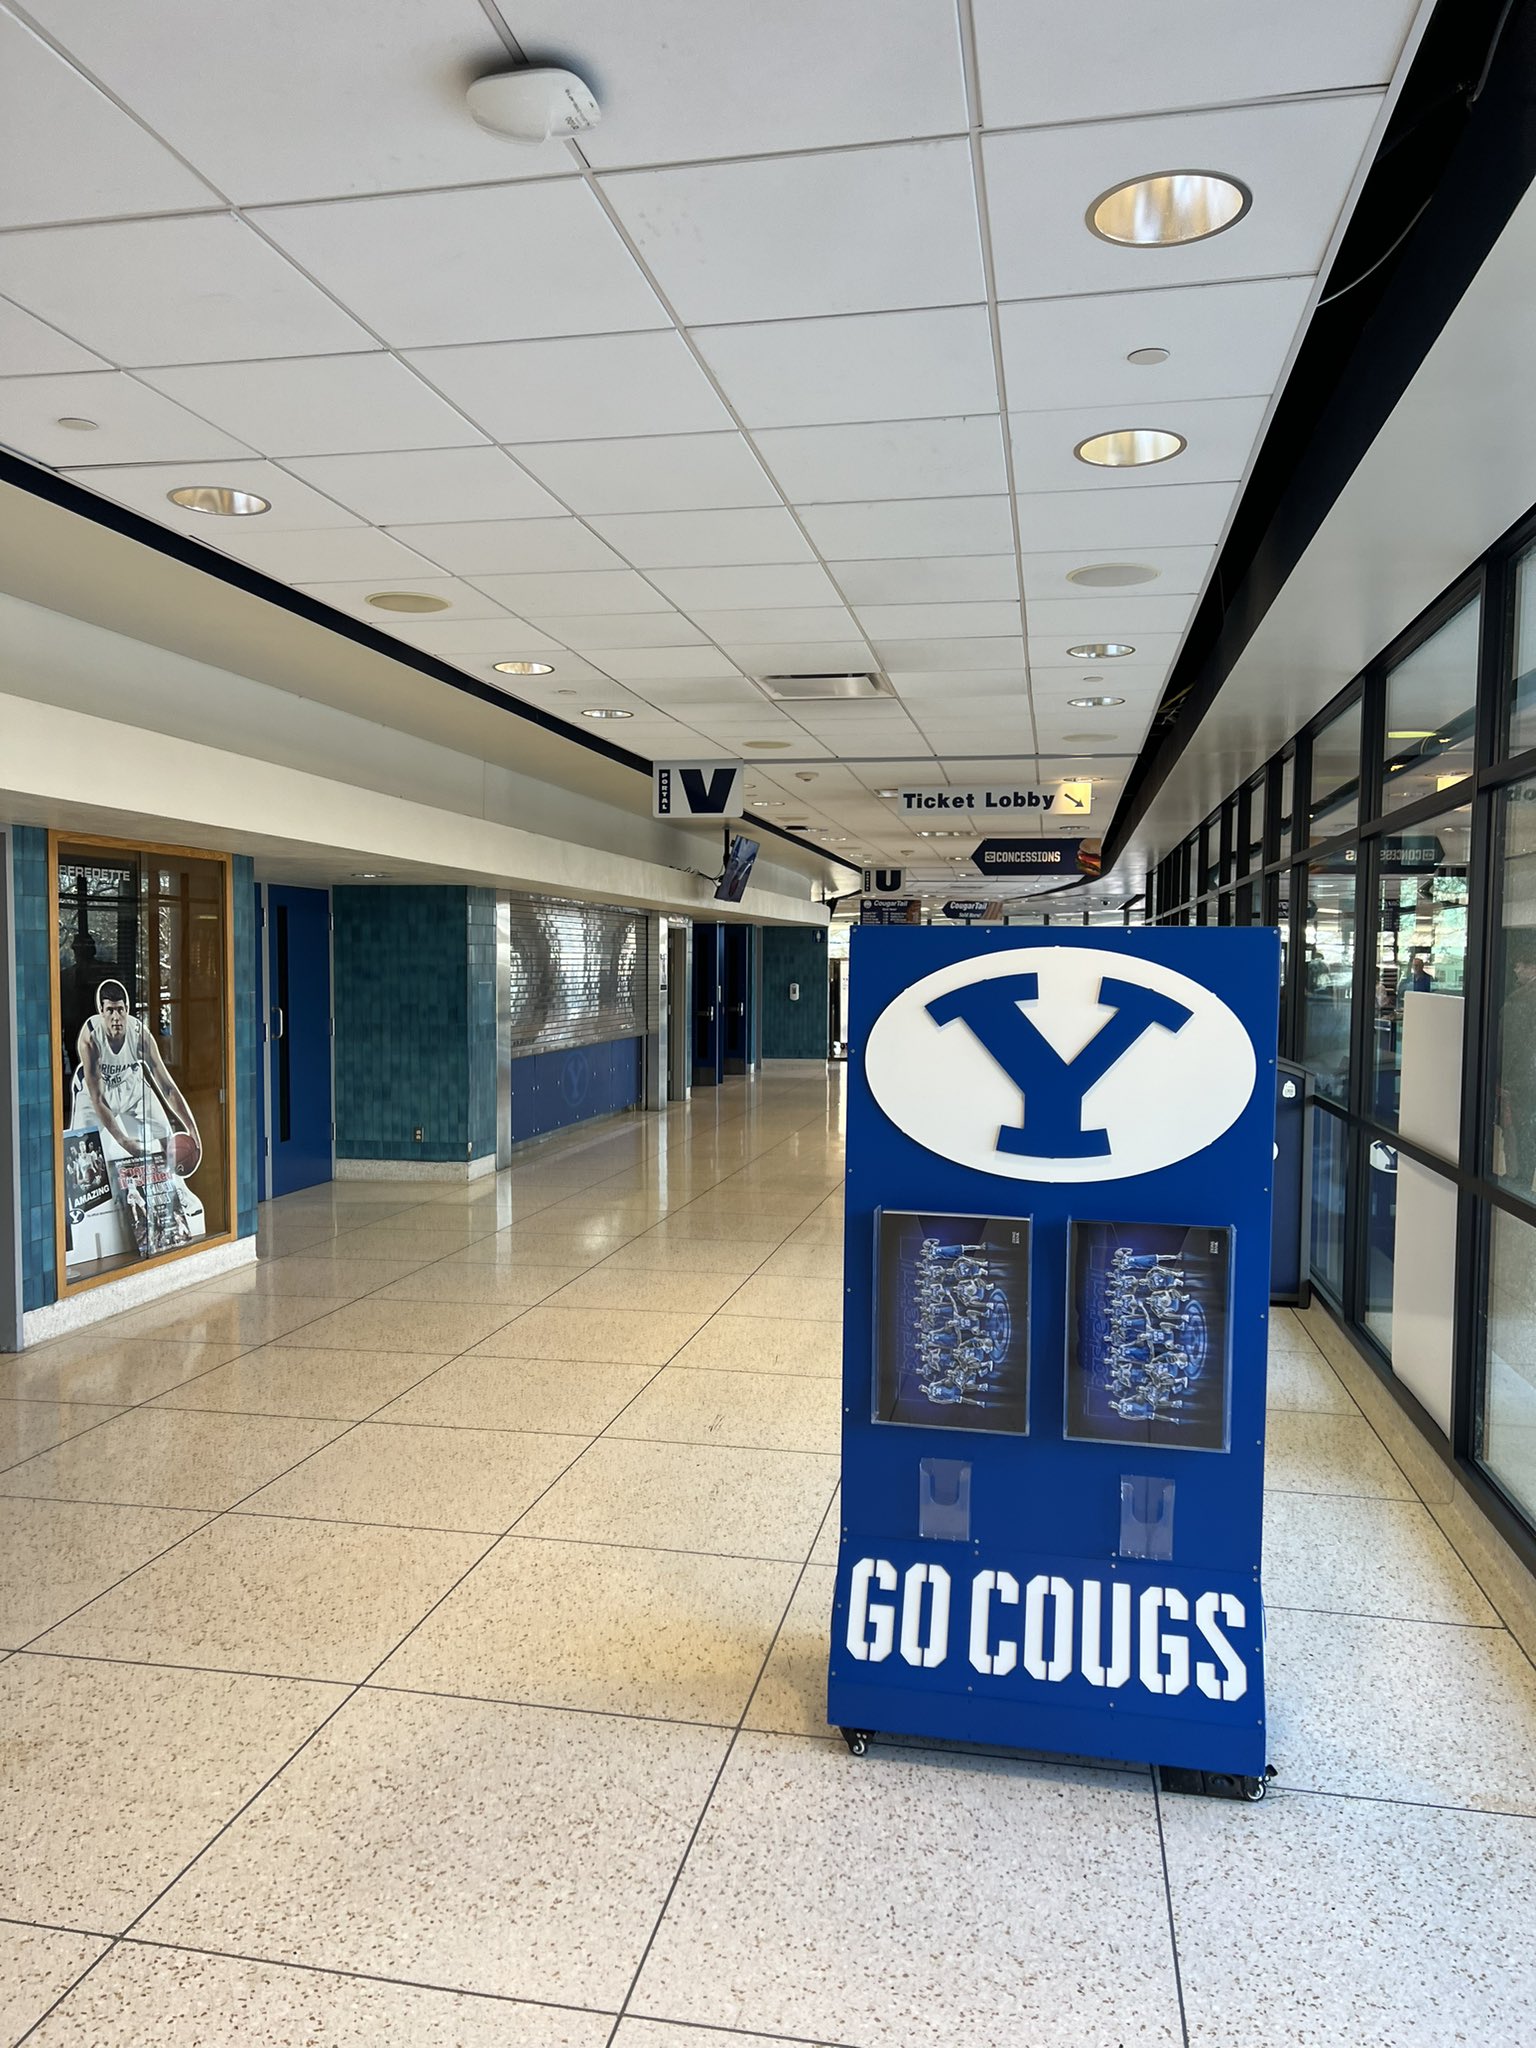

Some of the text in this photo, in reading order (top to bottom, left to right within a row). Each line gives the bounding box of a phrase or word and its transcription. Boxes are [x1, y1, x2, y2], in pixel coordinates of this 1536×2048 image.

[661, 772, 669, 810] PORTAL
[678, 768, 737, 813] V
[903, 791, 1056, 811] Ticket Lobby
[996, 851, 1061, 863] CONCESSIONS
[875, 870, 902, 891] U
[924, 972, 1194, 1159] Y
[74, 1184, 110, 1208] AMAZING
[846, 1557, 1248, 1702] GO COUGS
